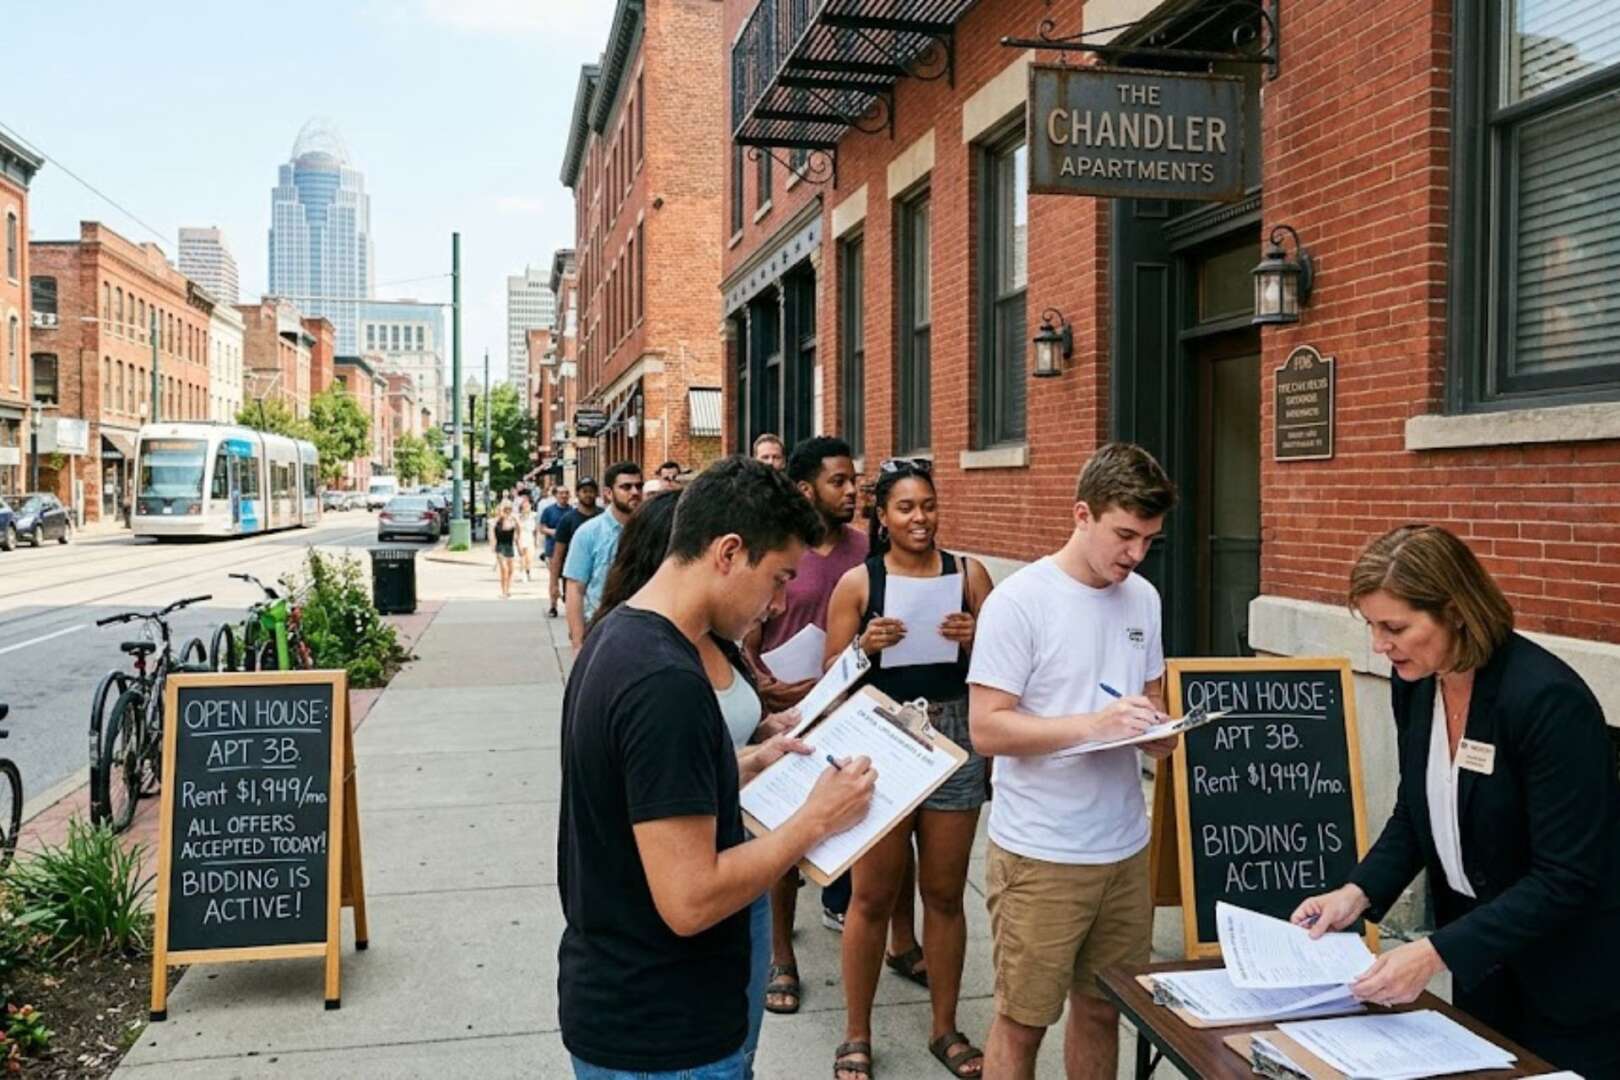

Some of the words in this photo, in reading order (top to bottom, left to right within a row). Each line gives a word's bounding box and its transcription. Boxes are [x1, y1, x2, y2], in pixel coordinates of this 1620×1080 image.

[1117, 83, 1161, 105] THE
[1048, 108, 1226, 153] CHANDLER
[1060, 156, 1215, 183] APARTMENTS
[1187, 681, 1248, 711] OPEN
[1256, 681, 1335, 711] HOUSE:
[184, 700, 247, 729] OPEN
[255, 699, 329, 726] HOUSE:
[1214, 725, 1254, 750] APT
[1265, 724, 1304, 750] 3B.
[206, 739, 254, 766] APT
[182, 781, 228, 809] Rent
[1193, 765, 1240, 796] Rent
[1248, 761, 1346, 799] $1,949/mo.
[187, 816, 221, 838] ALL
[227, 814, 296, 835] OFFERS
[1202, 823, 1307, 857] BIDDING
[1317, 822, 1343, 853] IS
[181, 837, 265, 860] ACCEPTED
[270, 831, 327, 854] TODAY!
[182, 868, 279, 897] BIDDING
[289, 866, 311, 889] IS
[1225, 855, 1326, 893] ACTIVE!
[203, 892, 301, 925] ACTIVE!
